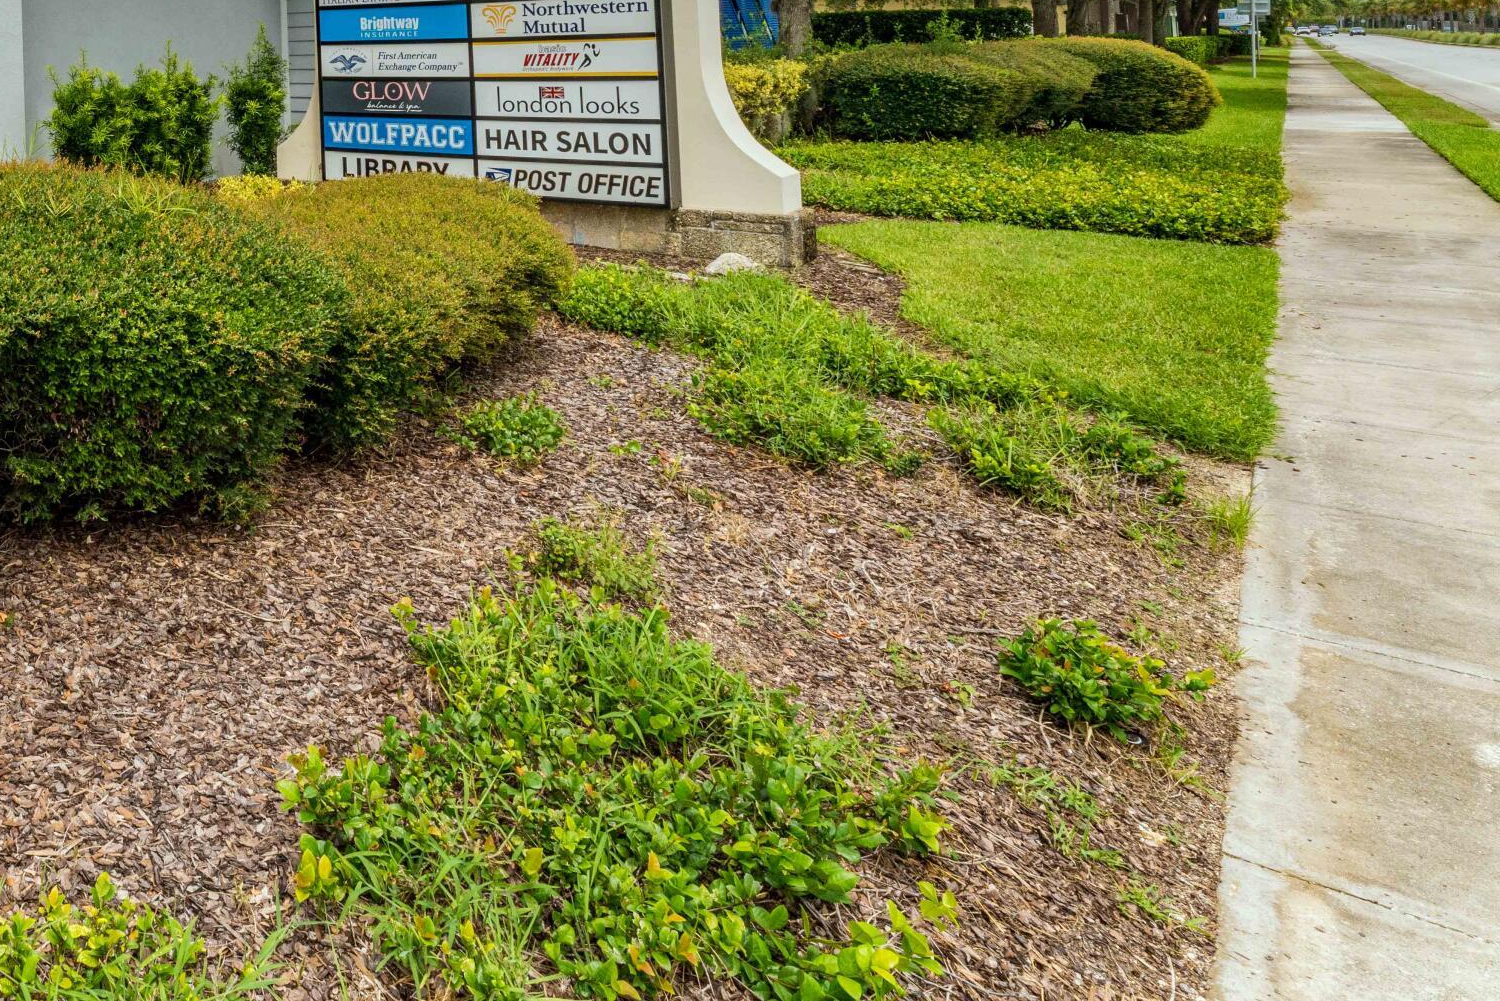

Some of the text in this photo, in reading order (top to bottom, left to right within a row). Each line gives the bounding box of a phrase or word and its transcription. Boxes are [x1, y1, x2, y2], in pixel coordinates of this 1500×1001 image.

[522, 0, 649, 17] Northwestern
[360, 16, 420, 31] Brightway
[523, 18, 586, 34] Mutual
[378, 51, 396, 60] First
[398, 51, 437, 60] American
[523, 52, 580, 67] VITALITY
[378, 63, 417, 72] Exchange
[352, 81, 432, 101] GLOW
[497, 86, 640, 114] london looks
[328, 121, 465, 149] WOLFPACC
[485, 128, 651, 155] HAIR SALON
[514, 169, 661, 198] POST OFFICE
